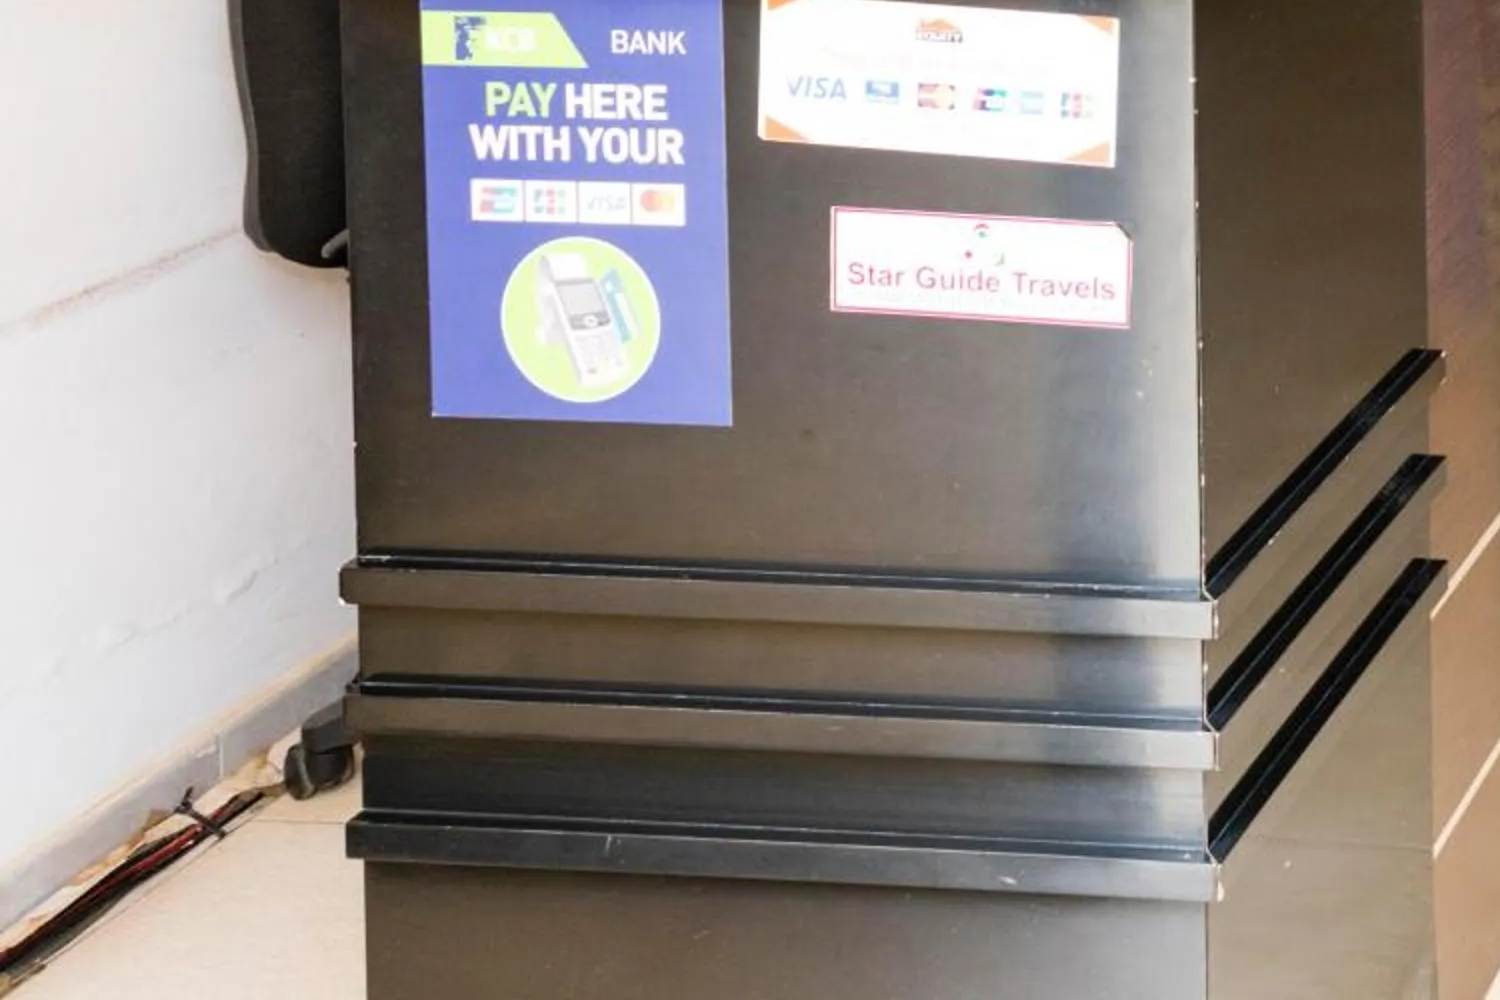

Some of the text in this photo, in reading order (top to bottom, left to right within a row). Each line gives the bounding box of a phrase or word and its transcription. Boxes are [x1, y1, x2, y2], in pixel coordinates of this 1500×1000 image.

[611, 29, 688, 55] BANK
[485, 82, 668, 121] PAY HERE
[787, 75, 847, 100] VISA
[469, 124, 685, 165] WITH YOUR
[847, 261, 1117, 301] Star Guide Travels
